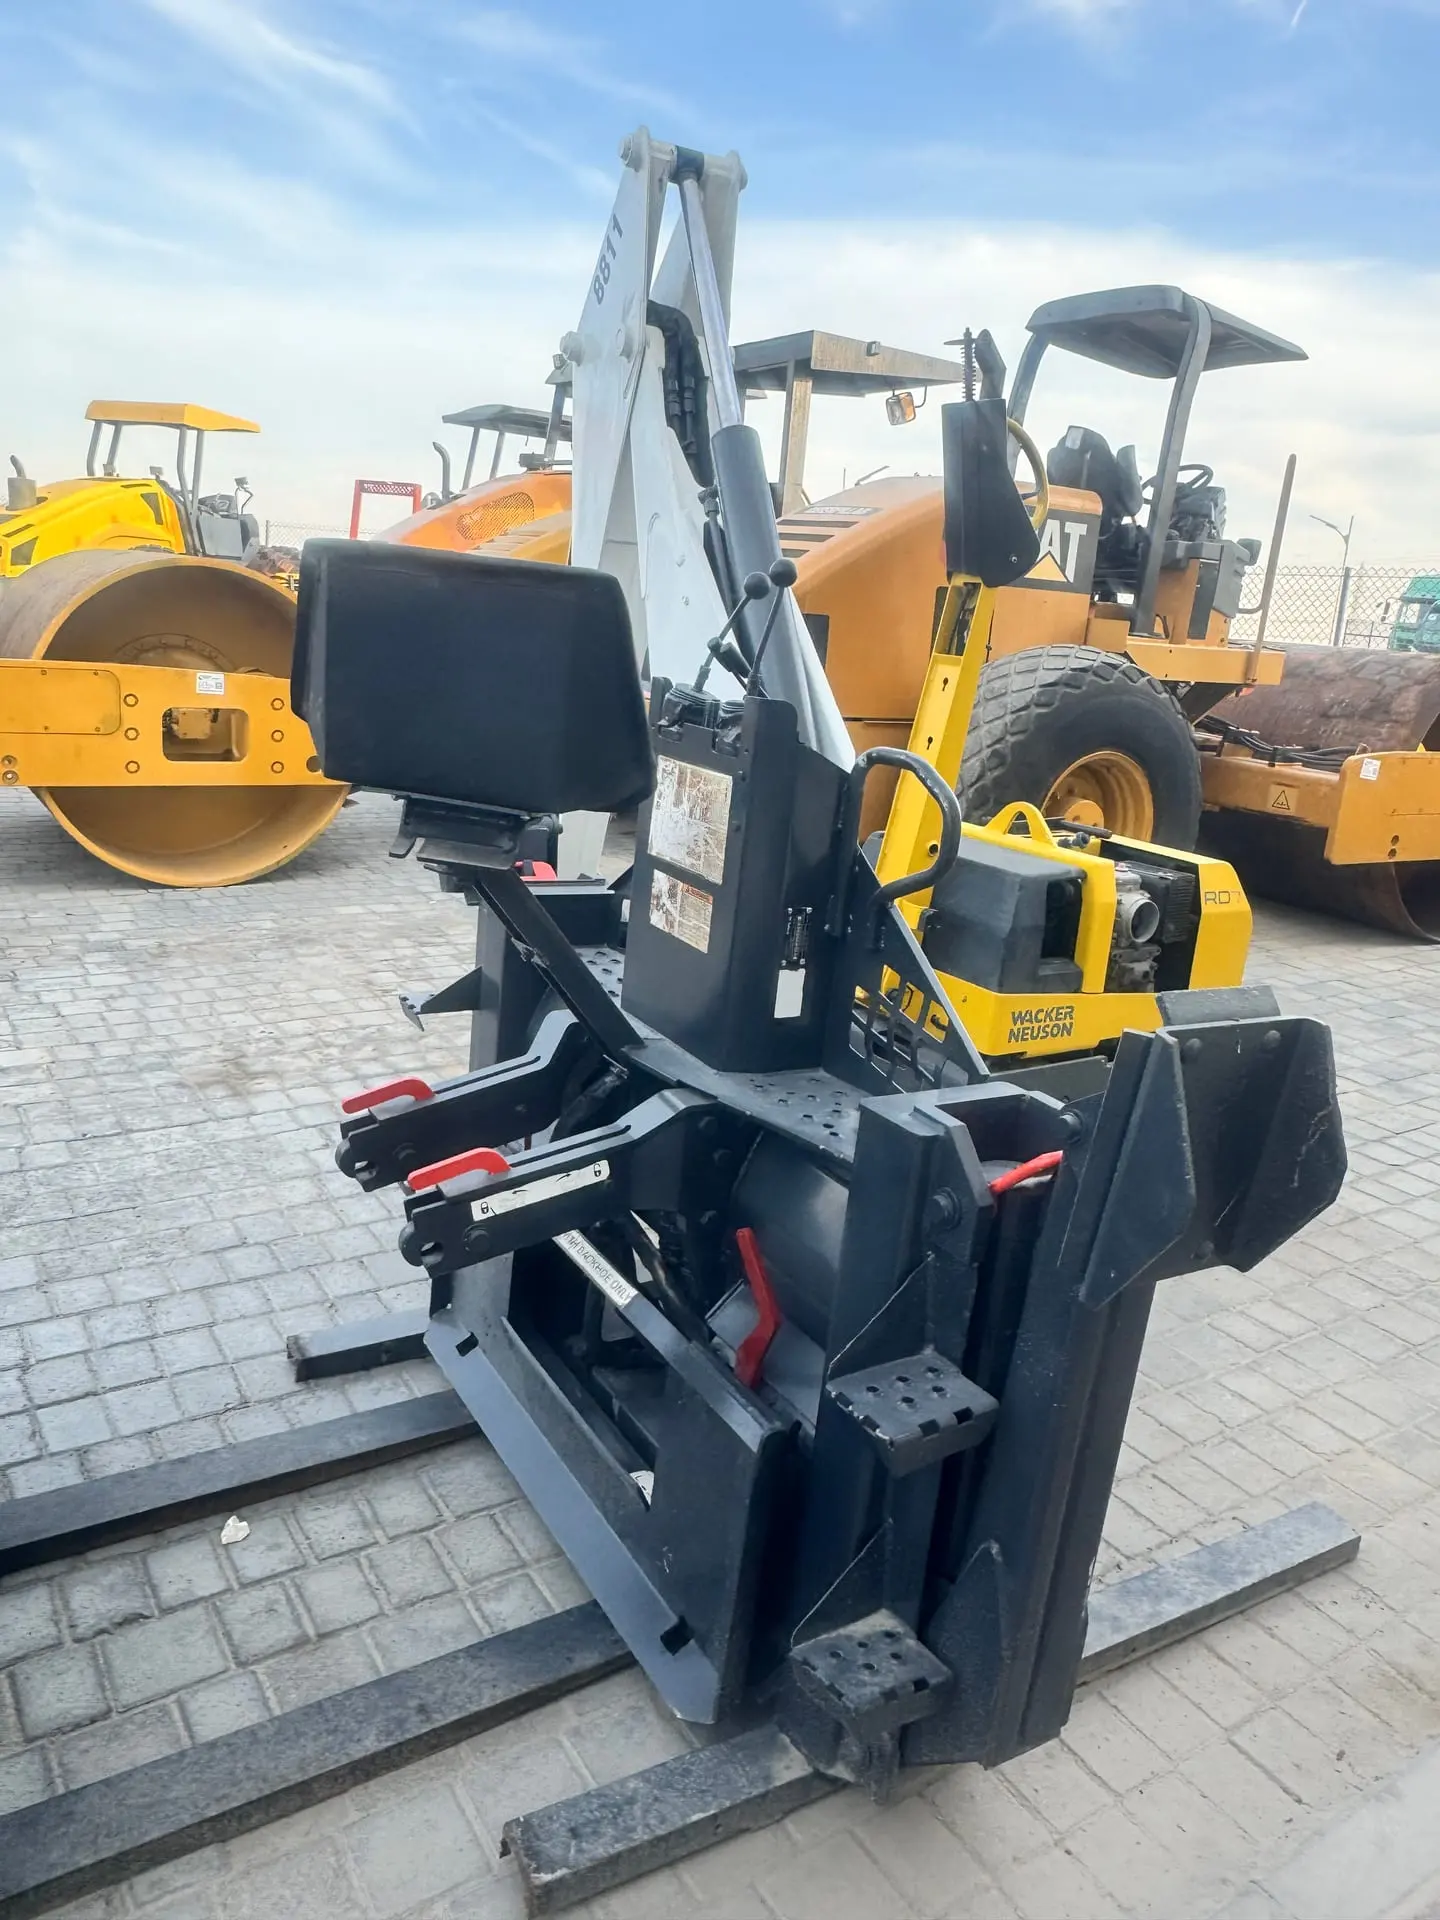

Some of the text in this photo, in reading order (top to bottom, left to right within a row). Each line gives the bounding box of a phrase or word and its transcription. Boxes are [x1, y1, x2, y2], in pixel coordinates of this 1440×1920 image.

[593, 213, 623, 305] 8811
[1035, 518, 1088, 583] AT
[1007, 1022, 1074, 1043] NEUSON
[1011, 1005, 1075, 1026] WACKER
[576, 1245, 614, 1283] BACKHOE
[610, 1279, 632, 1302] ONLY
